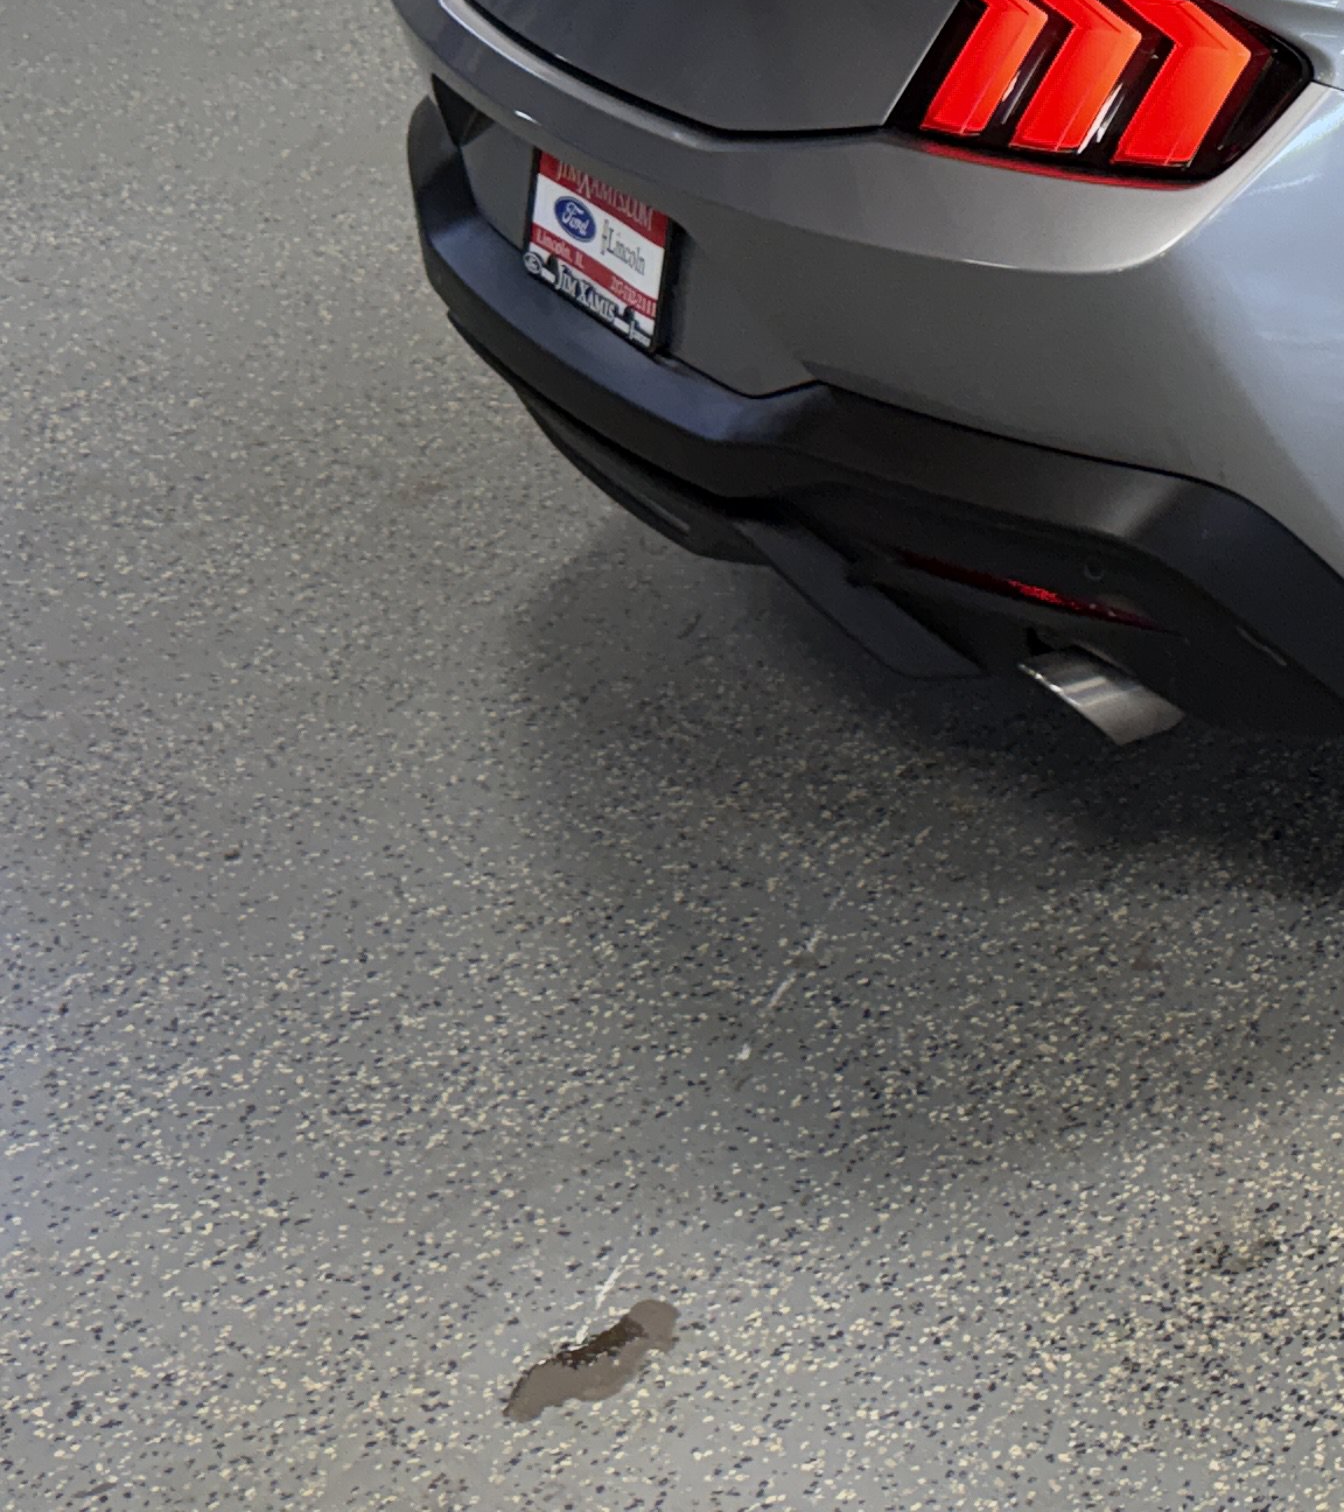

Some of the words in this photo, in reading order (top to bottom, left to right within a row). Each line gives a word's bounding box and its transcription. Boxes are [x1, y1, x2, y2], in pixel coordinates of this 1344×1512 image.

[607, 228, 646, 276] Lincoln
[555, 263, 578, 298] JIM
[577, 280, 616, 323] XAMIS
